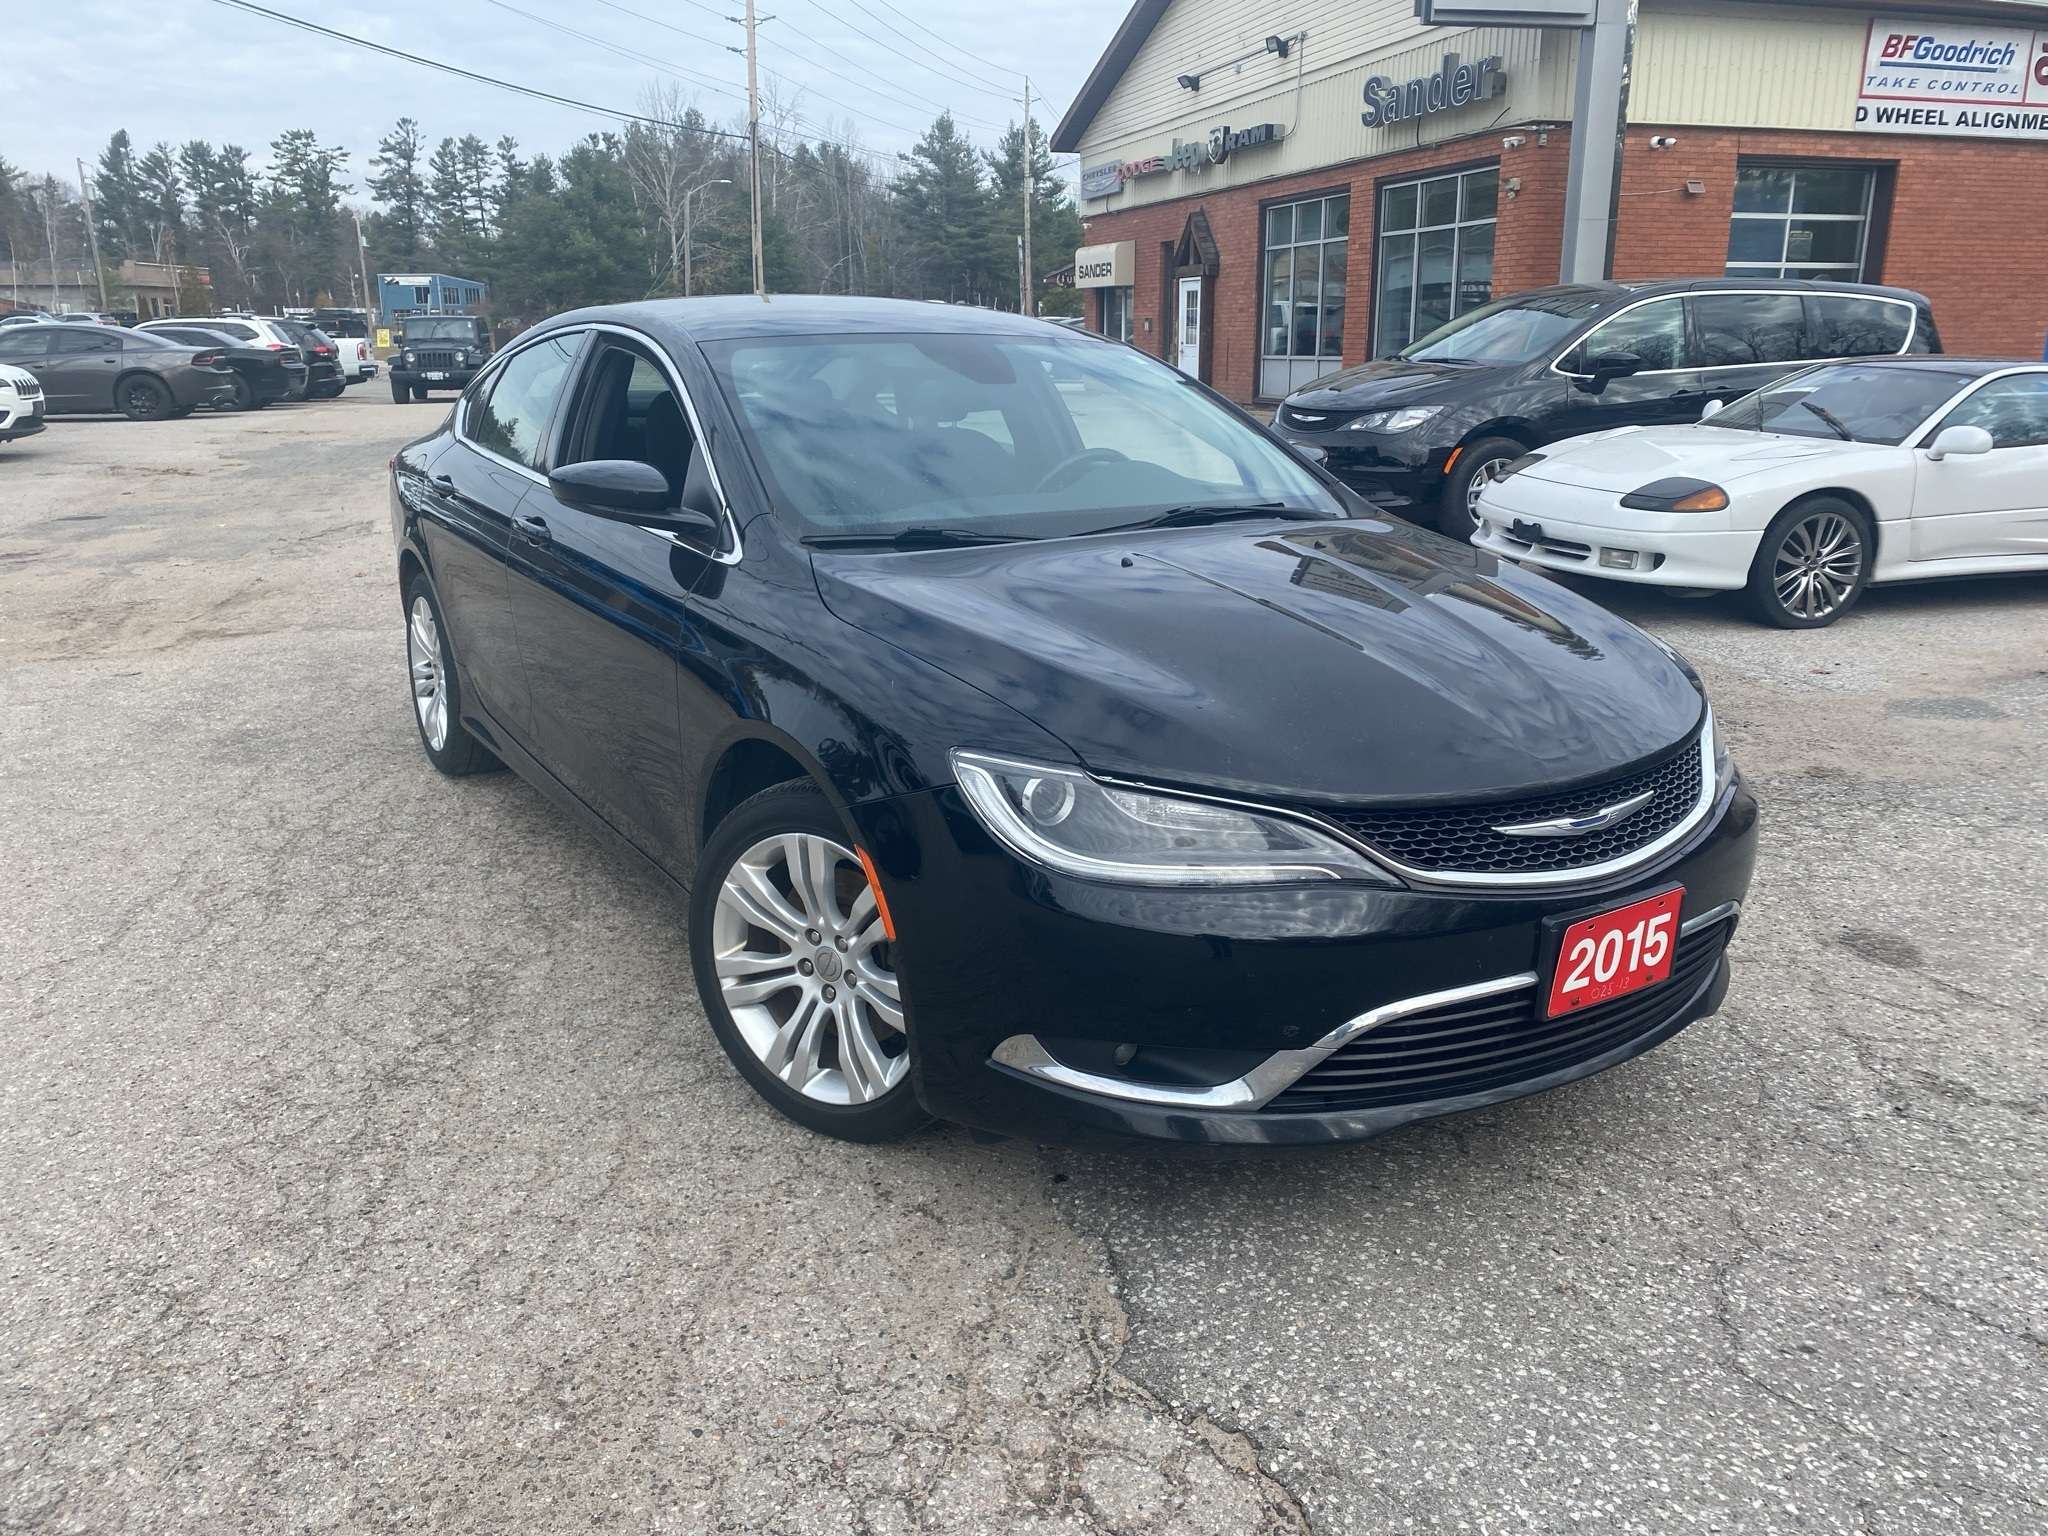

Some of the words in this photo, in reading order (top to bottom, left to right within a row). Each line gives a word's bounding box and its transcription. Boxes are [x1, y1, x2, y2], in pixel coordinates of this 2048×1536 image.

[1881, 34, 2016, 65] BFGoodrich
[1361, 52, 1502, 128] Sander
[1865, 75, 1920, 89] TAKE
[1927, 79, 2022, 95] CONTROL
[1876, 107, 1949, 126] WHEEL
[1166, 138, 1203, 175] Jeep
[1225, 124, 1269, 151] RAM
[1078, 262, 1112, 279] SANDER
[1561, 912, 1672, 994] 2015
